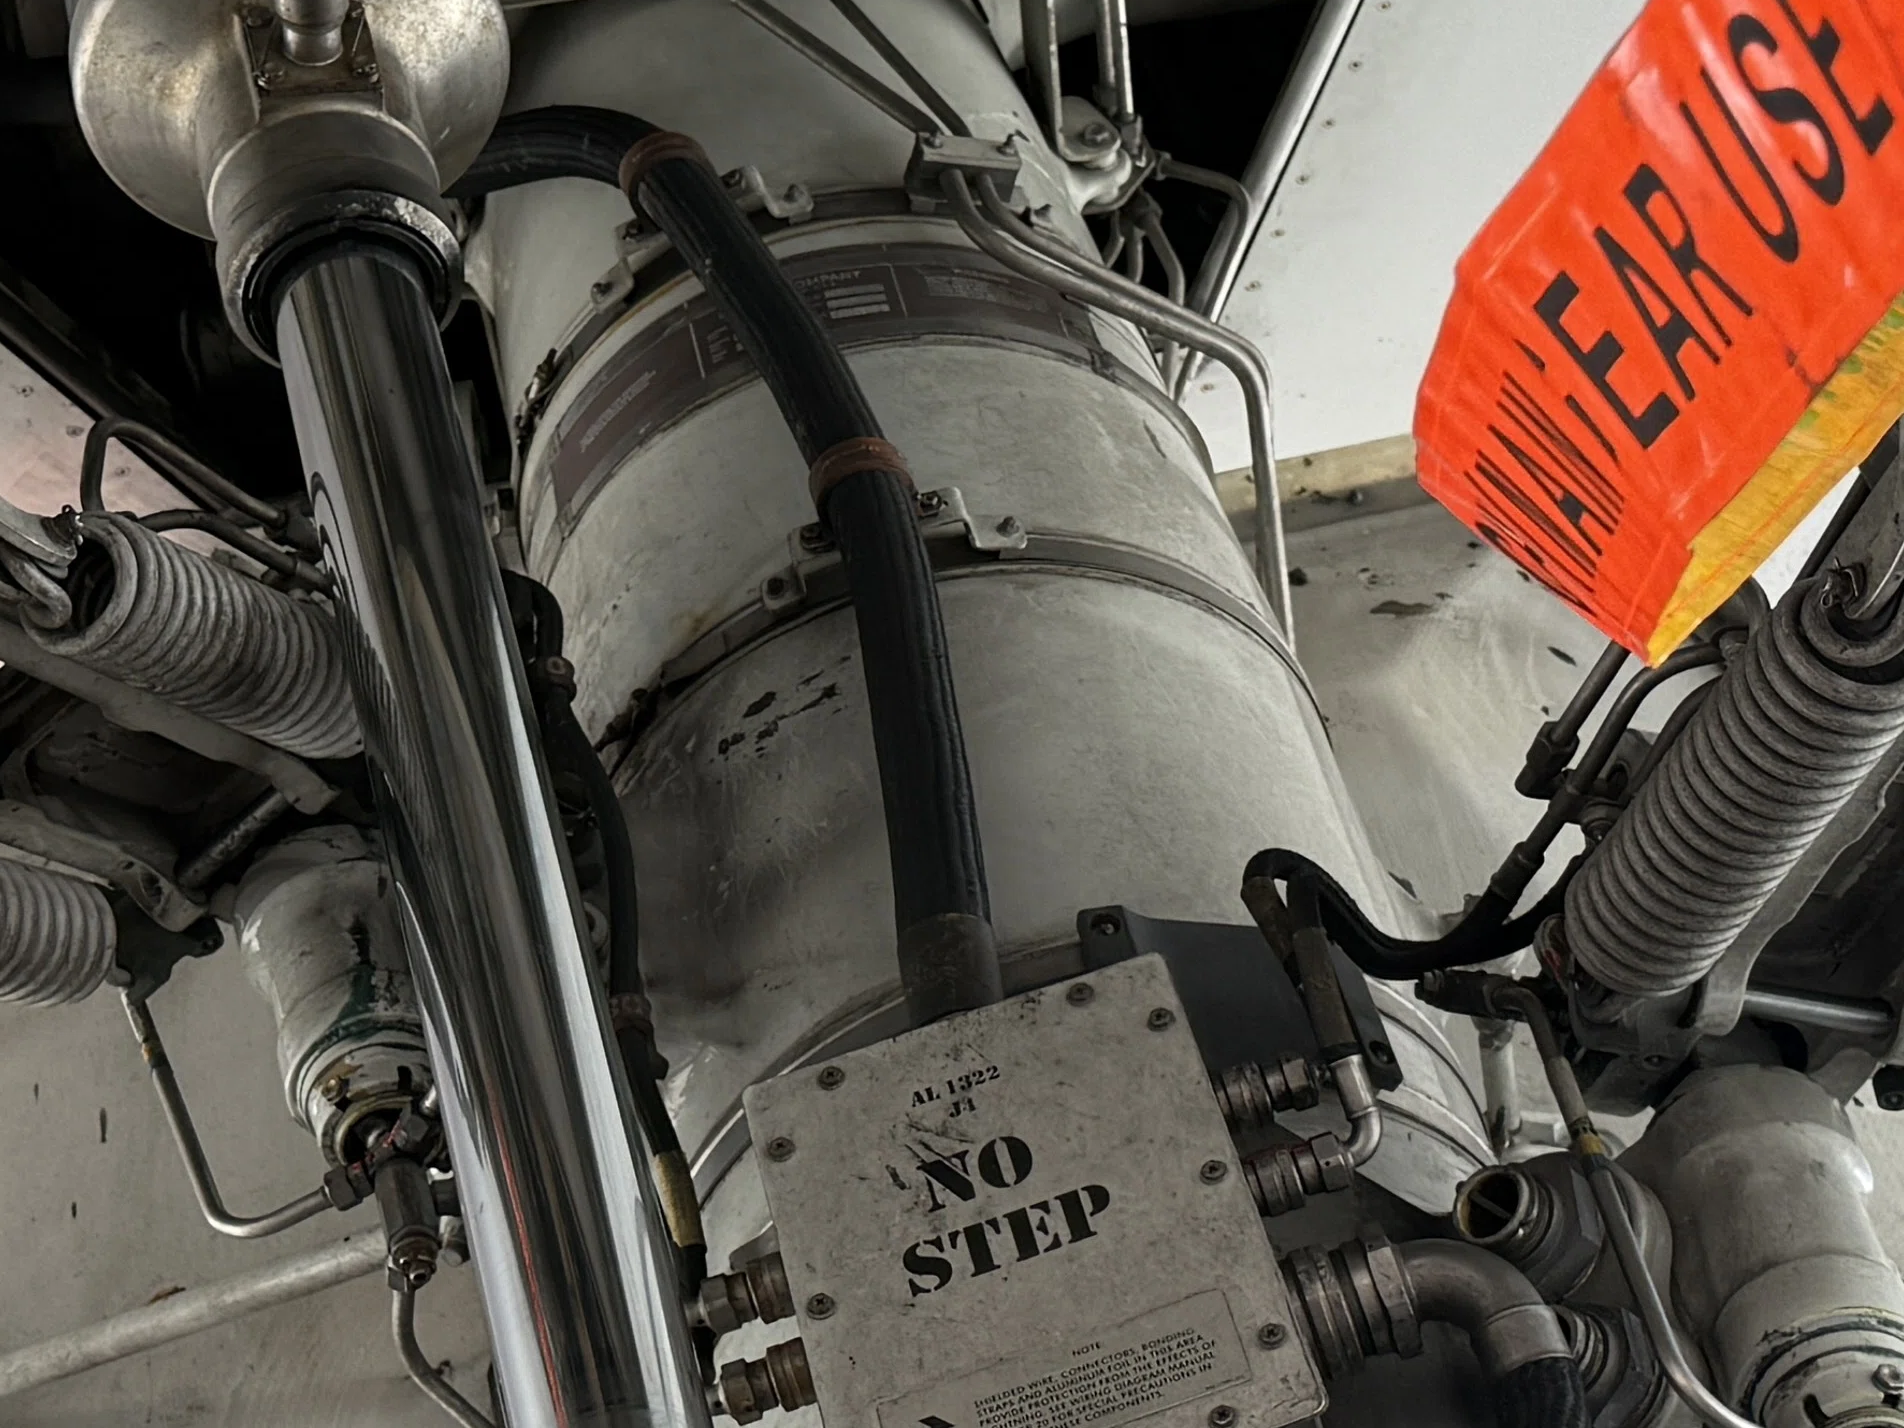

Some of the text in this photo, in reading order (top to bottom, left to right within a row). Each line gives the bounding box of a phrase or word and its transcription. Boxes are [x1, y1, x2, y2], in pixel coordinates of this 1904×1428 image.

[793, 270, 861, 291] OMPANY
[911, 1065, 1001, 1108] AL 1322
[916, 1135, 1034, 1213] NO
[902, 1183, 1111, 1298] STEP
[1141, 1328, 1195, 1352] BONDING
[976, 1334, 1204, 1418] STRAPS AND ALUMINUM FOIL IN THIS AREA
[979, 1339, 1216, 1427] PROVIDE PROTECTION FROM THE EFFECTS OF
[1048, 1402, 1067, 1414] SEE
[1069, 1388, 1112, 1406] WIRING
[1114, 1368, 1166, 1391] DIAGRAM
[1168, 1351, 1216, 1372] MANUAL
[1052, 1411, 1074, 1423] FOR
[1077, 1396, 1119, 1414] SPECIAL
[1121, 1369, 1197, 1399] PRECAUTIONS
[1199, 1362, 1213, 1373] IN
